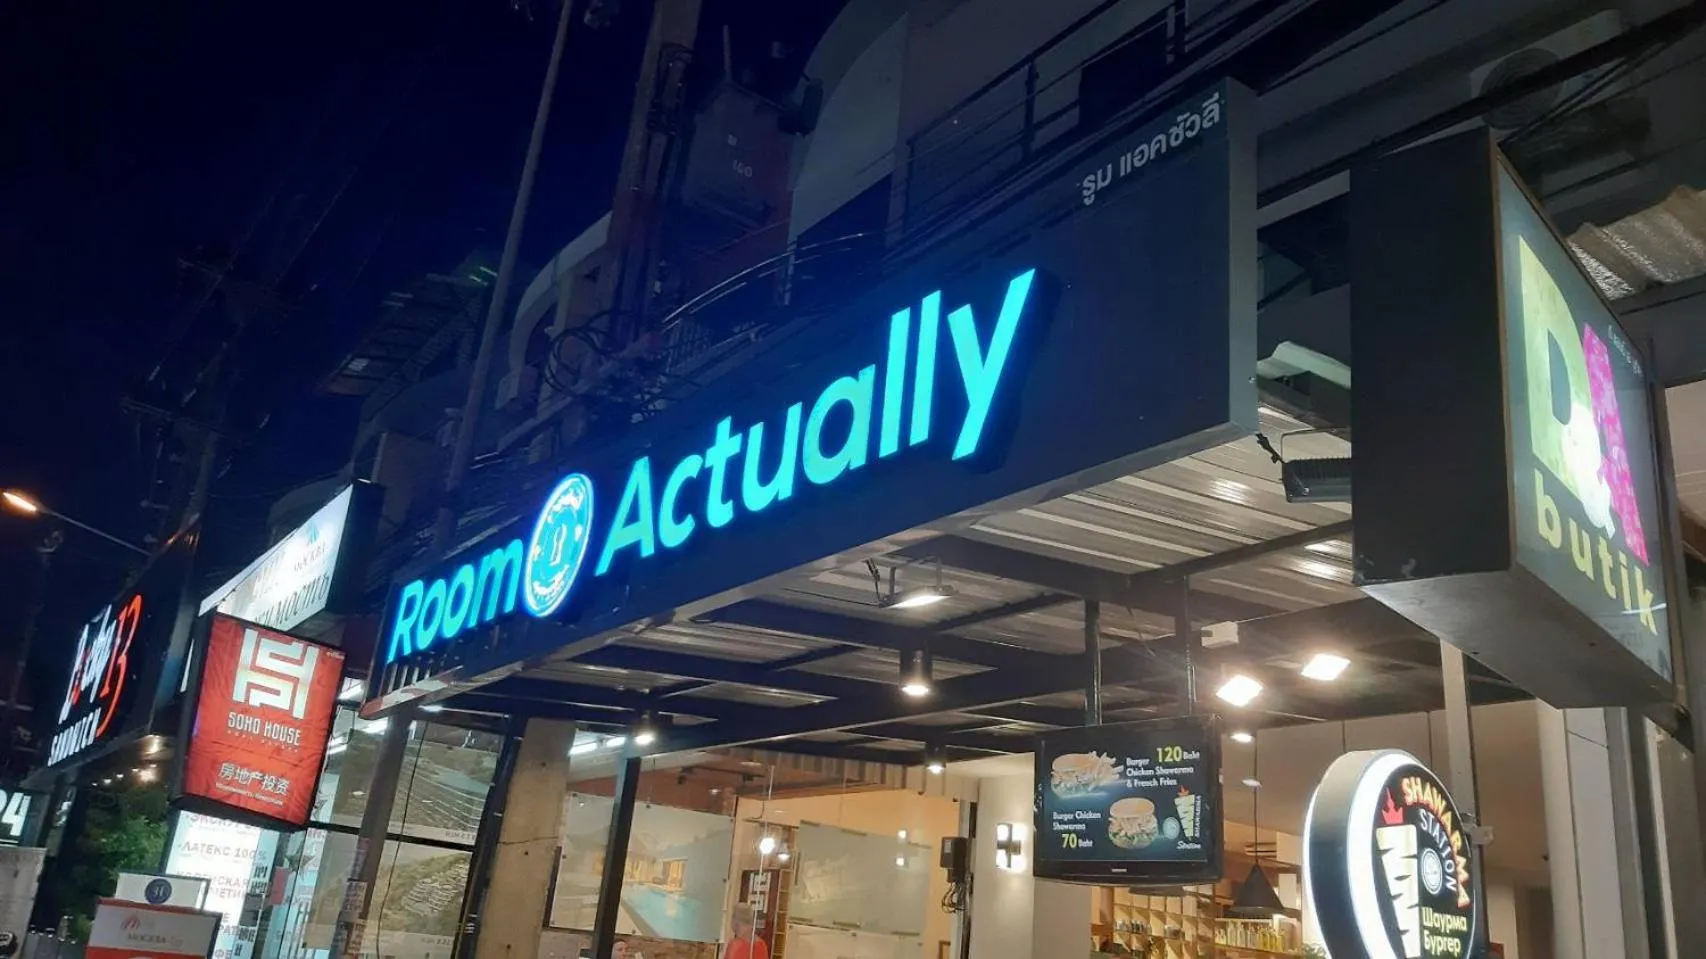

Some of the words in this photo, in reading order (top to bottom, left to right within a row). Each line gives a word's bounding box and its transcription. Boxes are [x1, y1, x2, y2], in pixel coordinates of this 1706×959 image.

[1083, 164, 1112, 206] รูม
[387, 537, 524, 664] Room
[595, 269, 1035, 576] Actually
[1534, 468, 1658, 637] butik
[228, 711, 261, 735] SOHO
[264, 720, 302, 746] HOUSE
[1126, 757, 1150, 767] Burger
[1157, 746, 1183, 762] 120
[218, 762, 290, 796] 房地产投资
[1126, 767, 1155, 776] Chicken
[1134, 777, 1159, 787] French
[1160, 777, 1178, 786] Fries
[1052, 811, 1074, 821] Burger
[1075, 810, 1101, 819] Chicken
[1061, 833, 1077, 848] 70
[1401, 776, 1471, 908] SHAWARMA
[1418, 808, 1458, 892] STATION
[1422, 906, 1467, 932] Шаурма
[1423, 928, 1462, 956] Бургер
